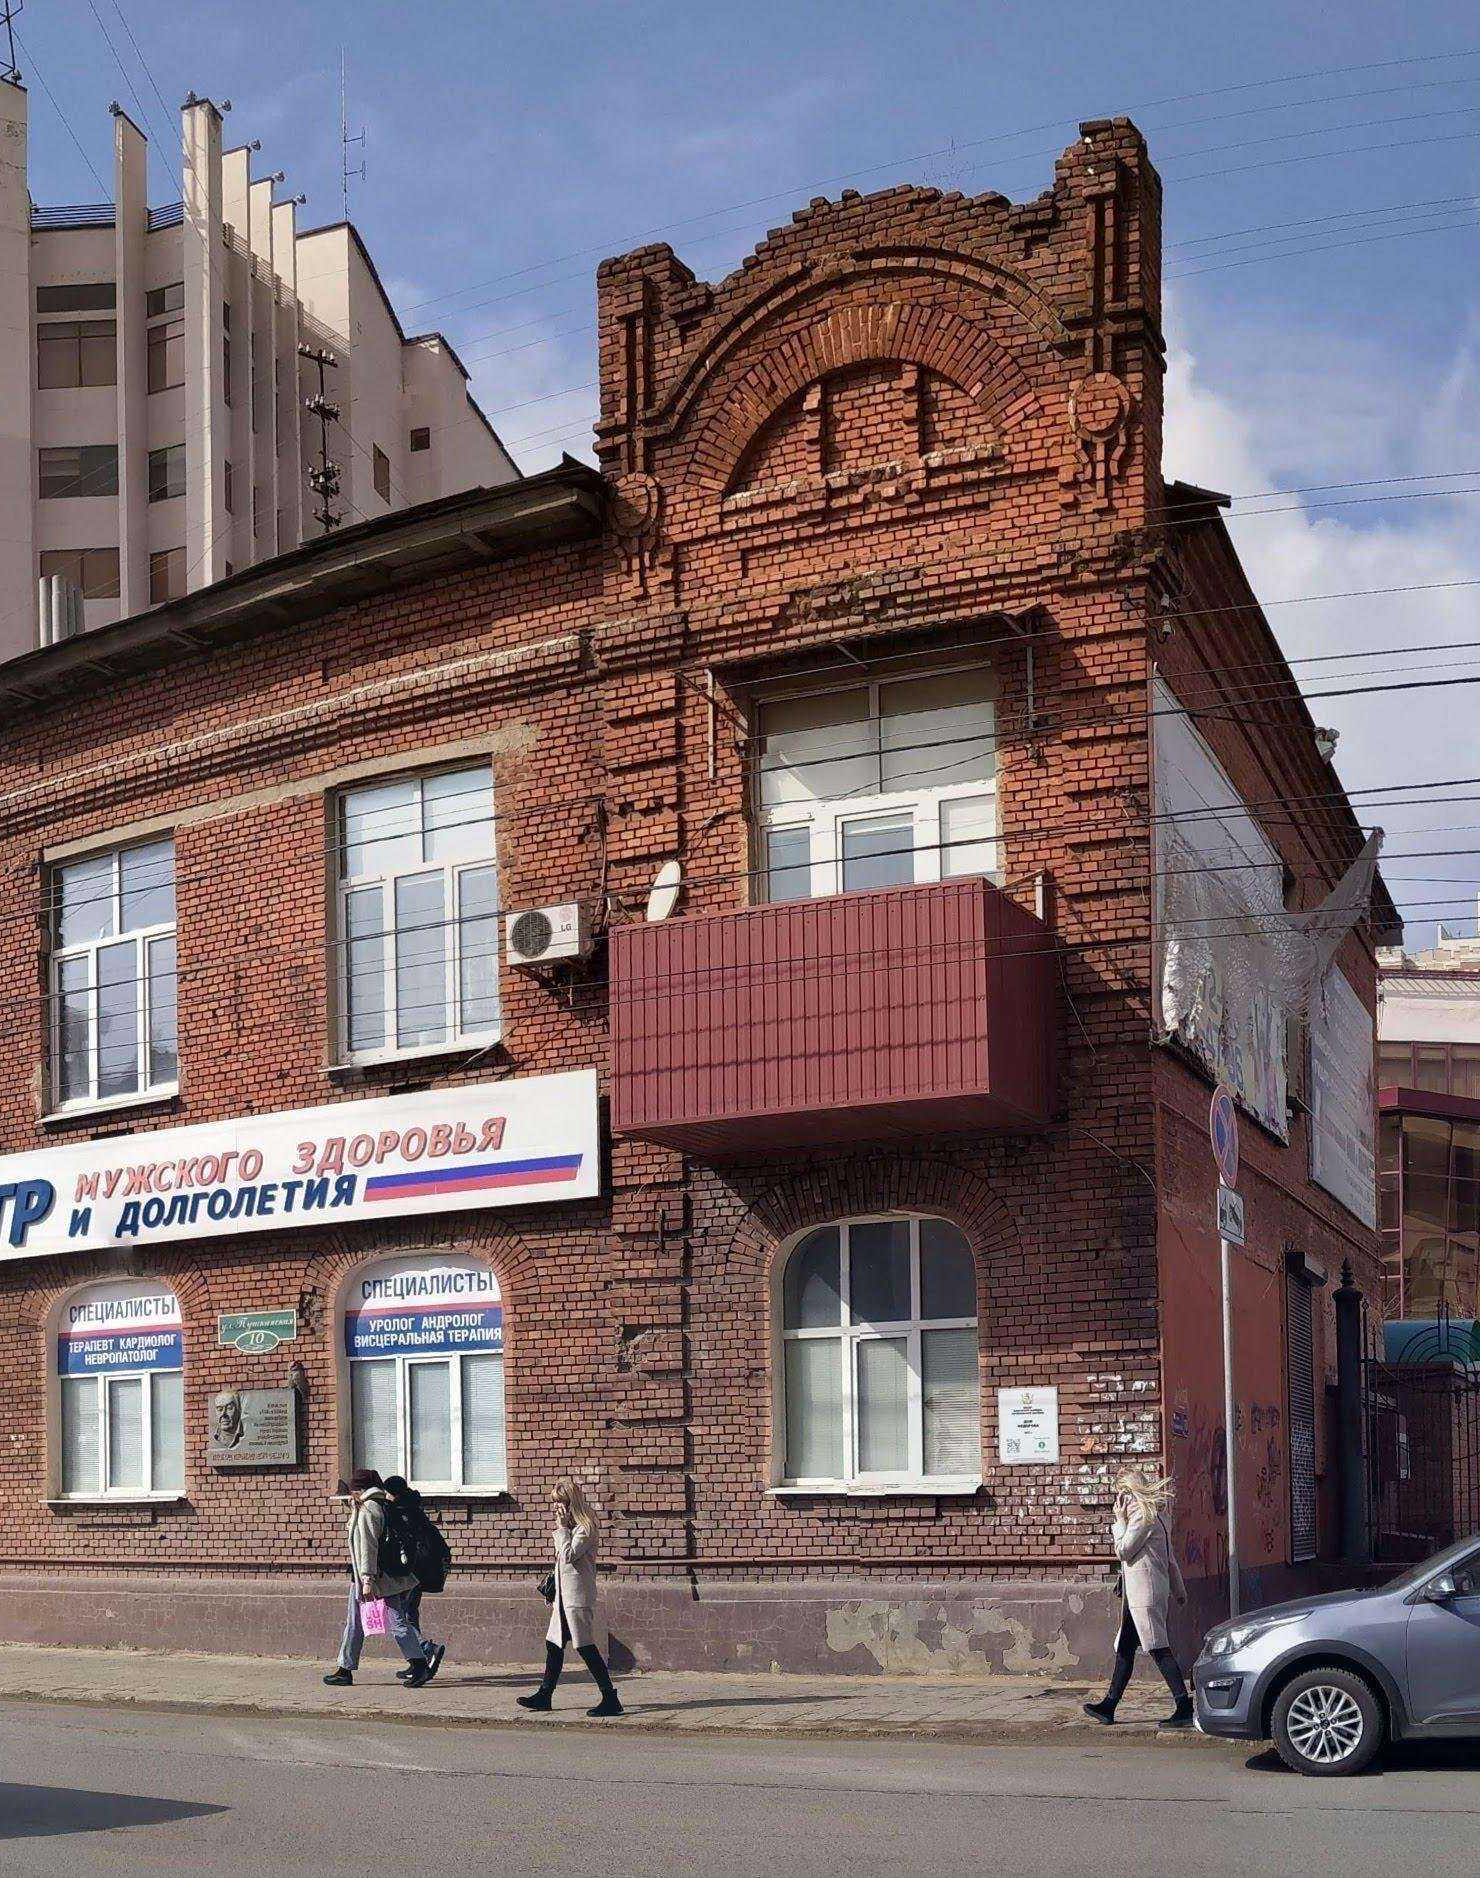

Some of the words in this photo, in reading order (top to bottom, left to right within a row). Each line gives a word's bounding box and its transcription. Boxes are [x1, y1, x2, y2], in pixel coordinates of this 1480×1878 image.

[75, 1149, 264, 1202] МУЖСКОГО
[292, 1116, 507, 1176] ЗДОРОВЬЯ
[115, 1174, 358, 1238] ДОЛГОЛЕТИЯ
[361, 1271, 493, 1300] СПЕЦИАЛИСТЫ
[69, 1297, 175, 1323] СПЕЦИАЛИСТЫ
[369, 1317, 416, 1333] УРОЛОГ
[421, 1313, 485, 1330] АНДРОЛОГ
[69, 1338, 115, 1354] ТЕРАПЕВТ
[120, 1334, 177, 1350] КАРДИОЛОГ
[250, 1333, 265, 1345] 10
[354, 1330, 445, 1348] ВИСЦЕРАЛЬНАЯ
[447, 1327, 502, 1343] ТЕРАПИЯ
[84, 1349, 159, 1366] НЕВРОПАТОЛОГ
